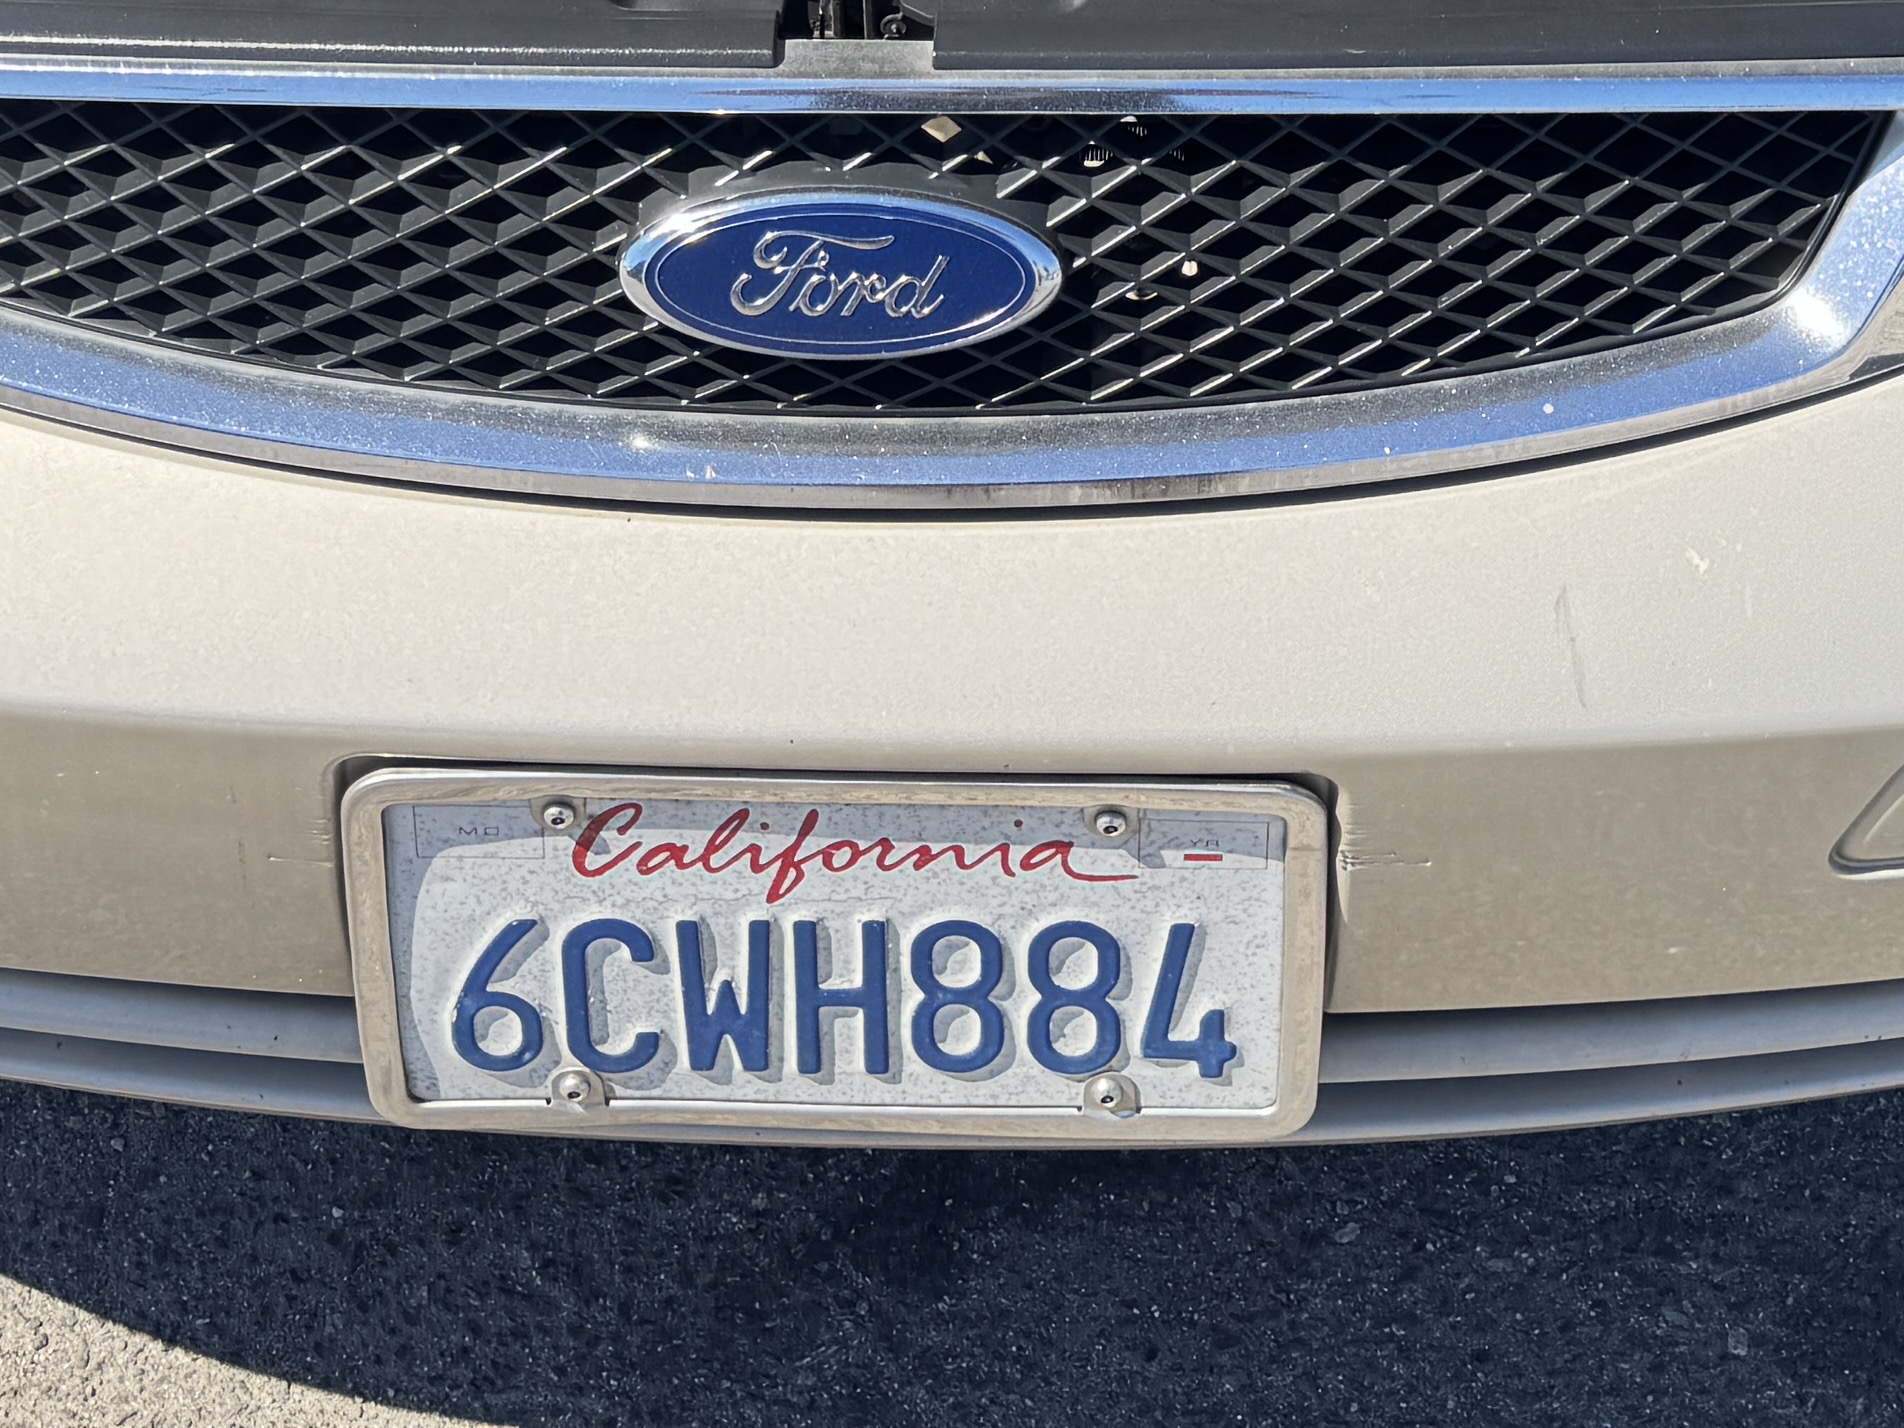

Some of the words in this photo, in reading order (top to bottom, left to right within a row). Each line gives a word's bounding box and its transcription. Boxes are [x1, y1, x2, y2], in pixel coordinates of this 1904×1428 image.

[730, 230, 950, 319] Ford
[458, 826, 500, 837] MO
[571, 802, 1139, 905] California
[450, 918, 1237, 1079] 6CWH884
